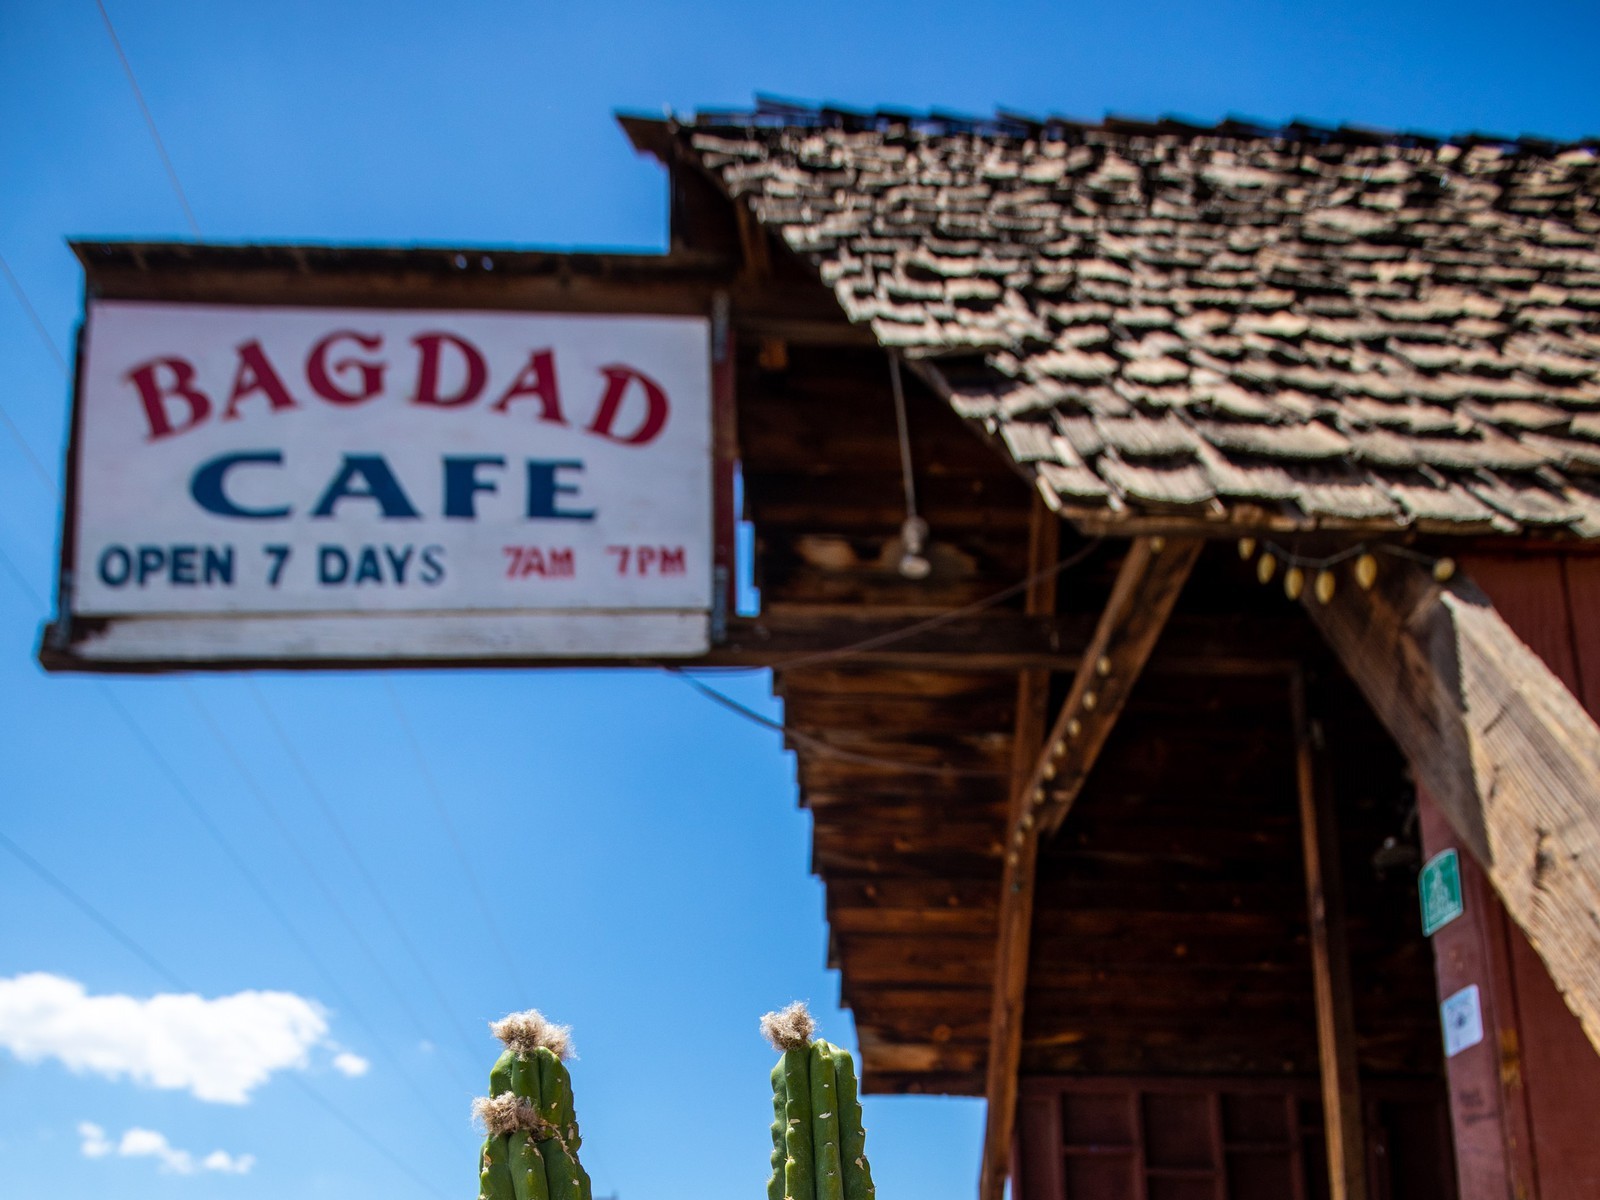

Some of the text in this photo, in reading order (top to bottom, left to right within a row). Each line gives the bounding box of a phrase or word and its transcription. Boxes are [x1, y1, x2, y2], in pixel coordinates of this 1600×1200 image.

[123, 329, 671, 446] BAGDAD
[188, 449, 597, 521] CAFE
[98, 544, 687, 586] OPEN 7 DAYS 7AM 7PM
